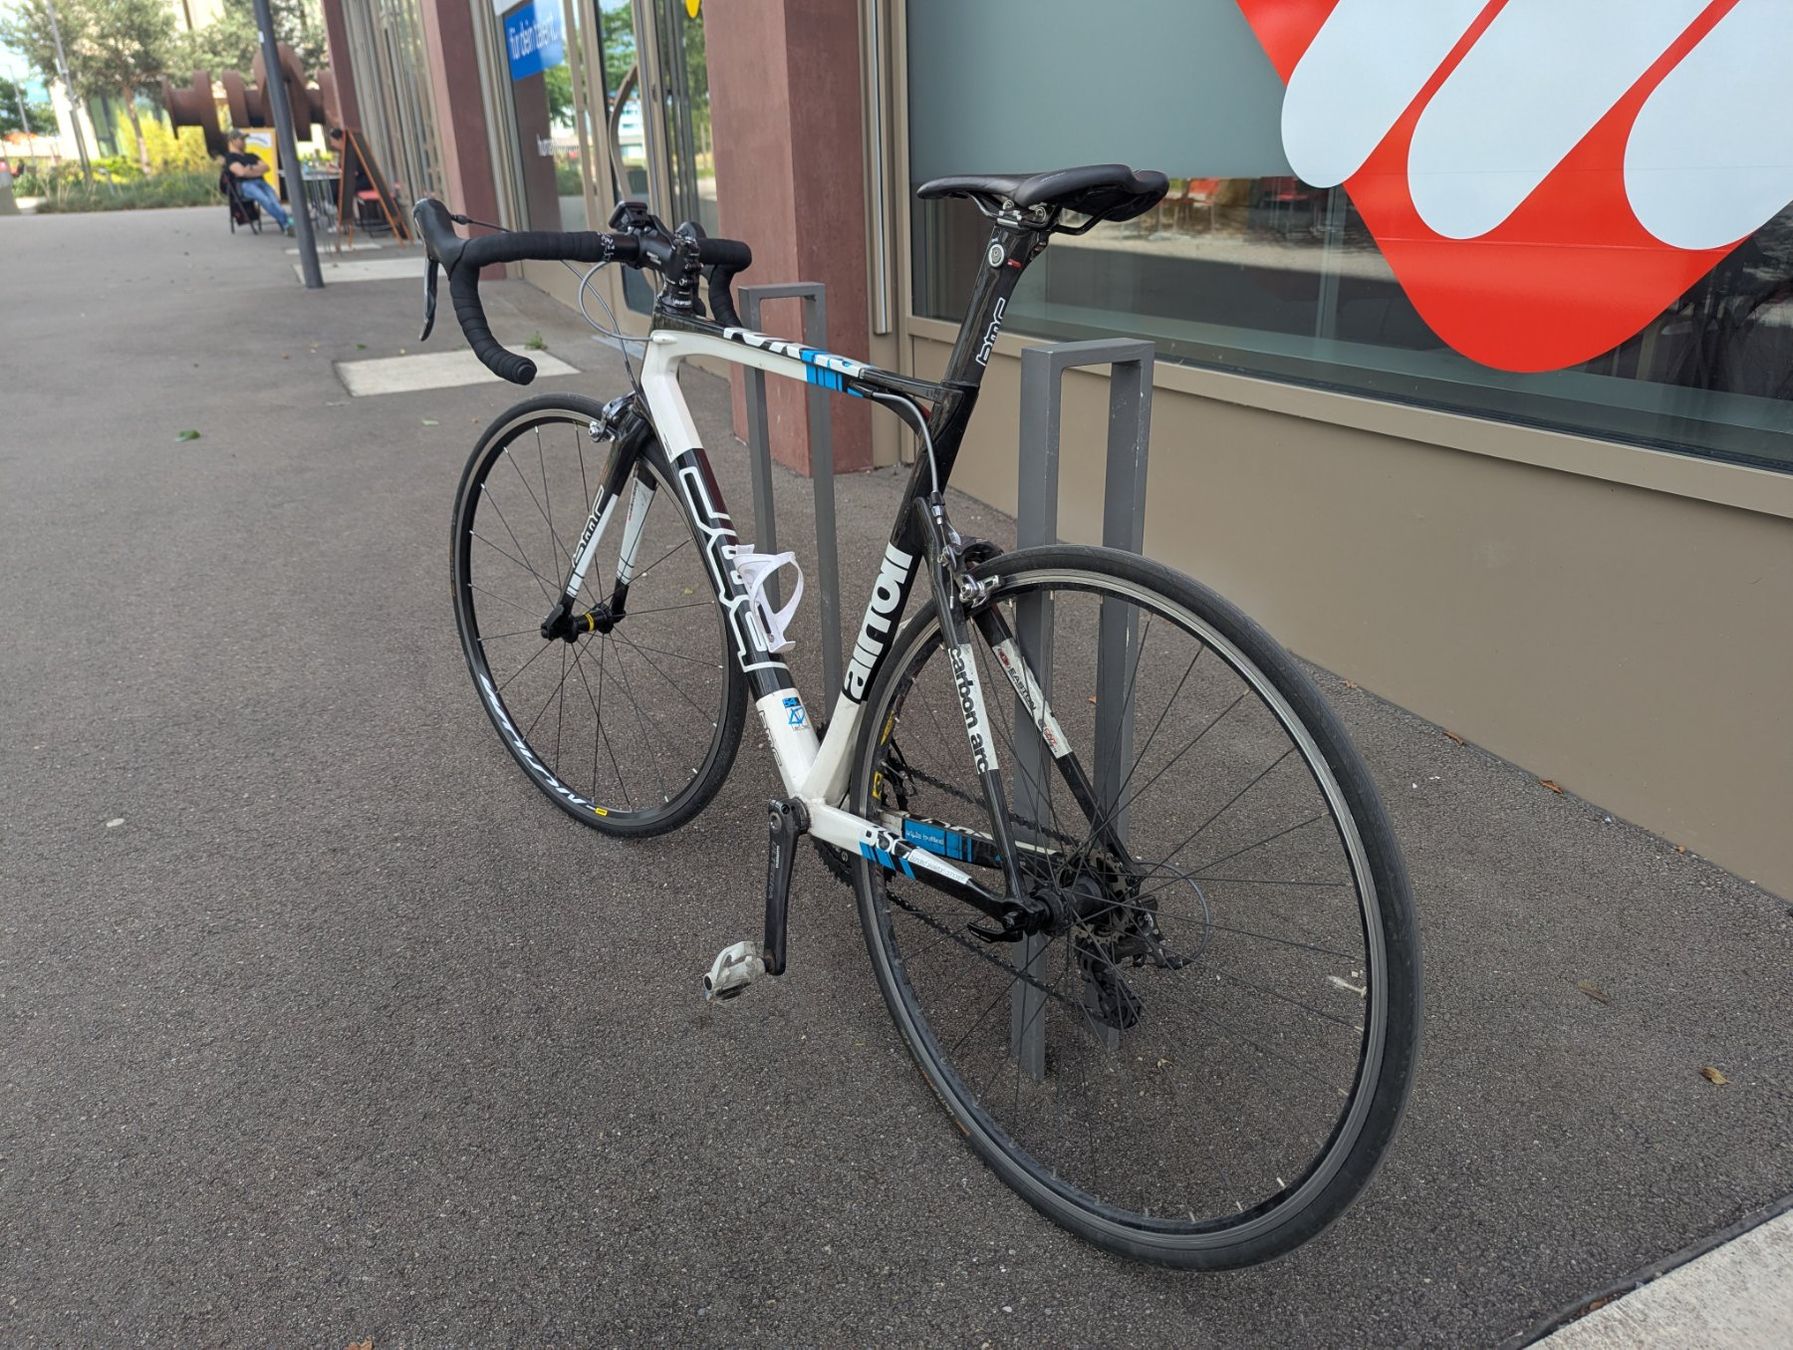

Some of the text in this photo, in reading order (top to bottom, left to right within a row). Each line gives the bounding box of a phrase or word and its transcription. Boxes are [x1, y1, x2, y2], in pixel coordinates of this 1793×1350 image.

[949, 648, 990, 775] carbon arc
[1008, 667, 1037, 711] EASTON
